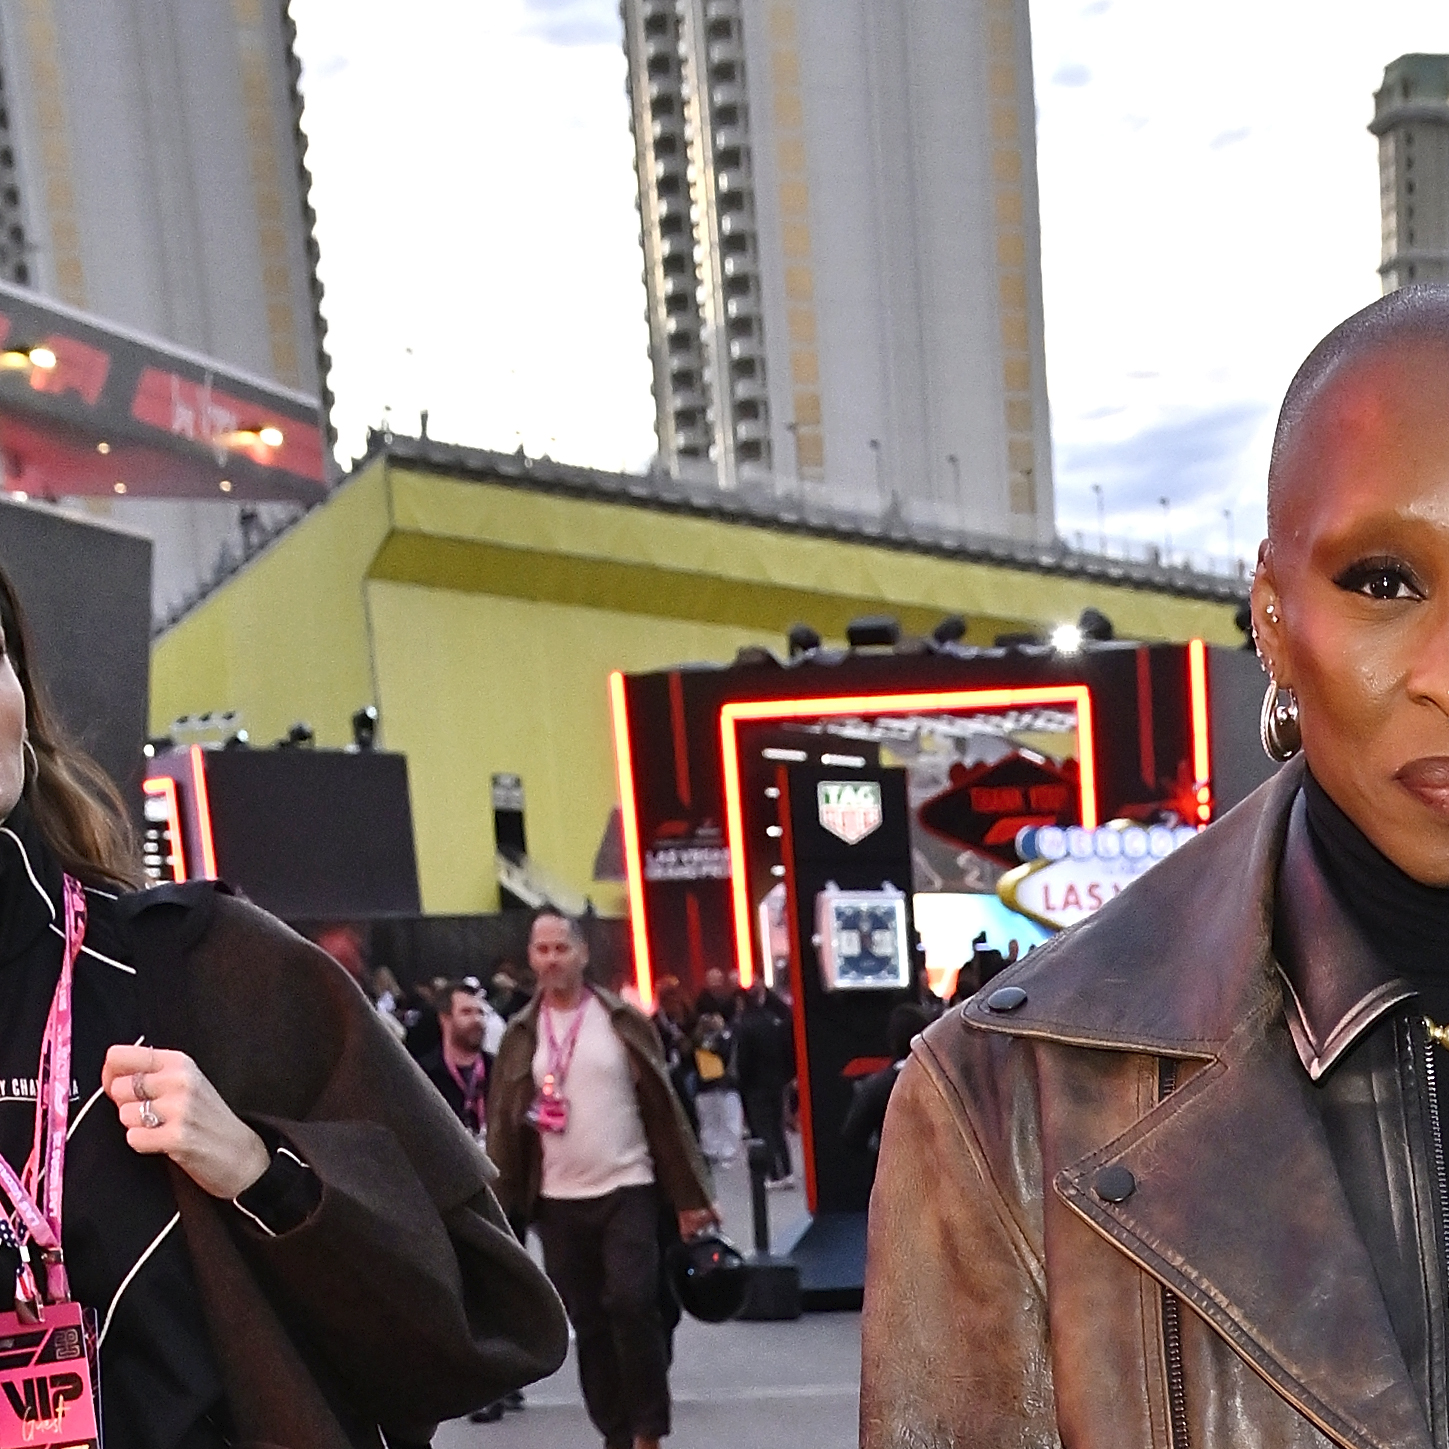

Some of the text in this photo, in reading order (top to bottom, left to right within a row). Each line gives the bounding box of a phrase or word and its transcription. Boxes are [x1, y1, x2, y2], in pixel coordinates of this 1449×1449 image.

[822, 785, 875, 807] TAG
[1041, 881, 1103, 911] LAS
[1, 1371, 84, 1422] VIP
[21, 1394, 71, 1442] Guest
